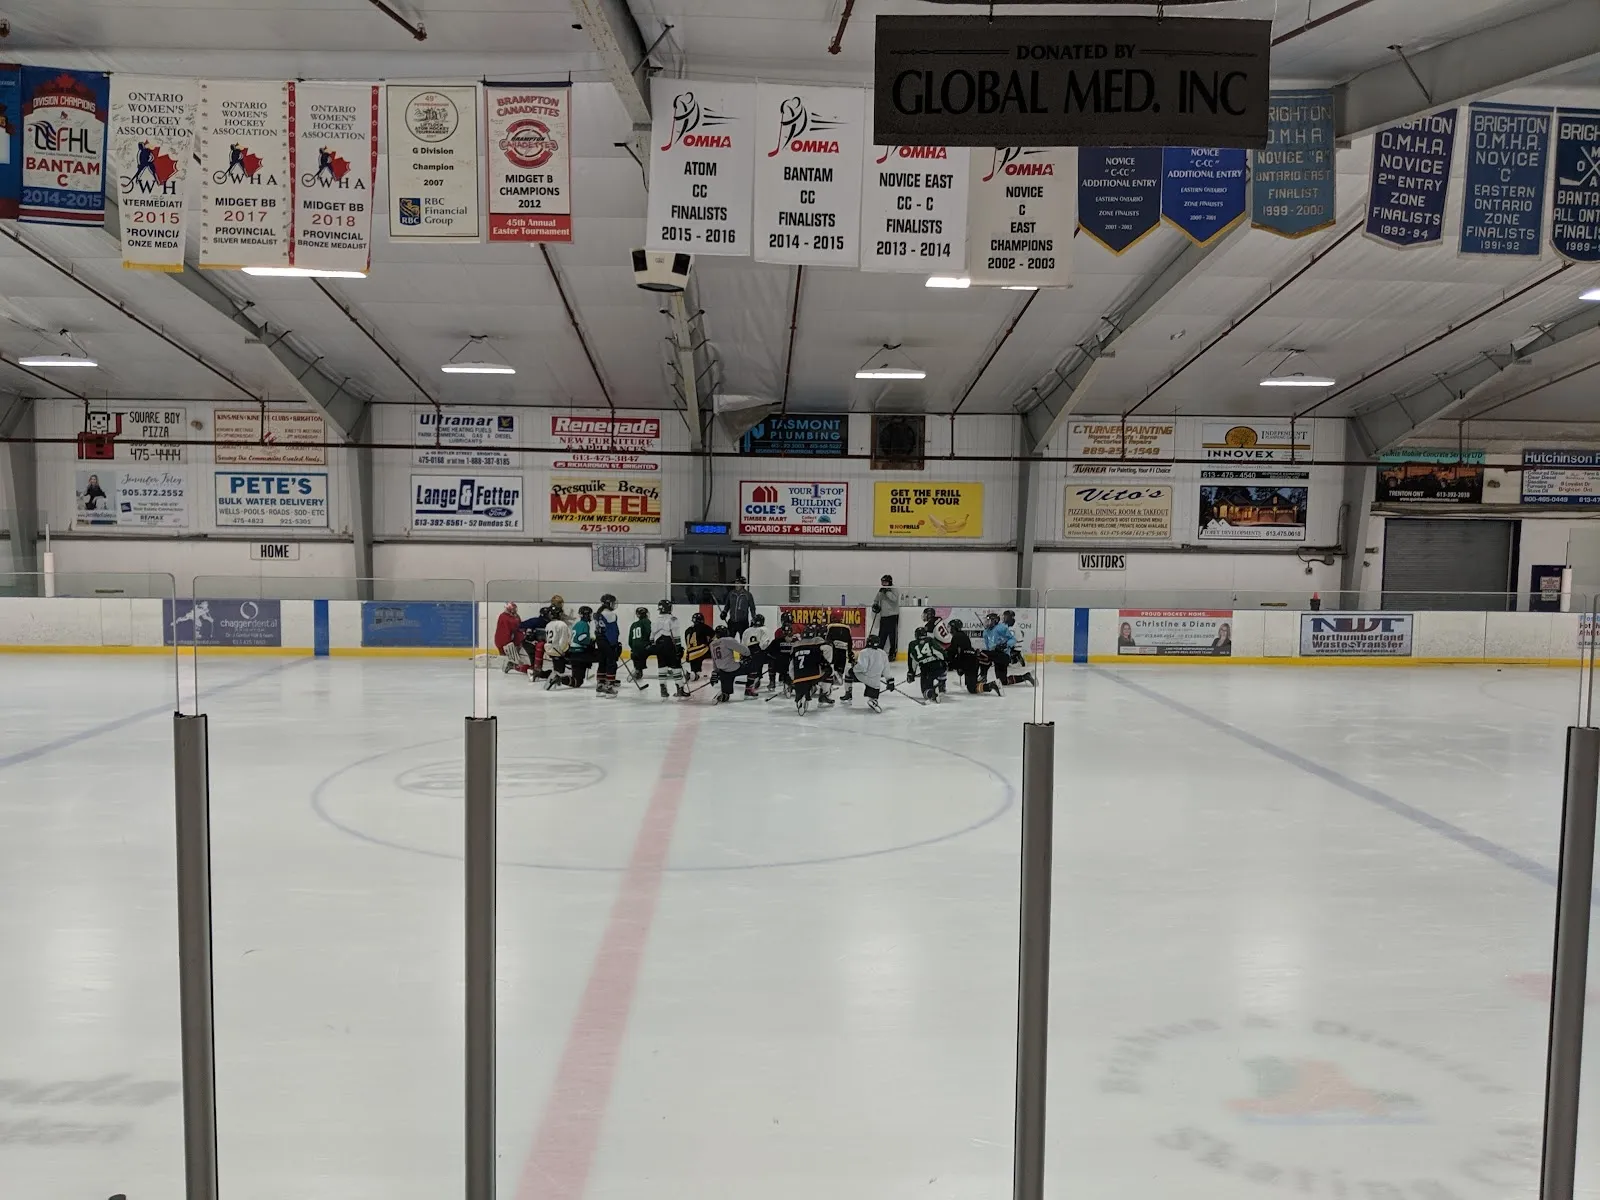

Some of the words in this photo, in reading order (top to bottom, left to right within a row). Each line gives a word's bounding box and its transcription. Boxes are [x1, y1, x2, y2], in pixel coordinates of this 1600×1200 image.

[1016, 45, 1108, 61] DONATED
[1115, 45, 1136, 59] BY
[129, 92, 183, 103] ONTARIO
[892, 69, 1048, 115] GLOBAL
[1063, 68, 1160, 114] MED.
[1178, 70, 1247, 116] INC
[33, 96, 58, 107] DIVISION
[60, 96, 96, 112] CHAMPIONS
[222, 101, 267, 109] ONTARIO
[496, 95, 559, 107] BRAMPTON
[128, 103, 184, 114] WOMEN'S
[222, 110, 268, 118] WOMEN'S
[311, 105, 356, 113] ONTARIO
[496, 105, 560, 118] CANADETTES
[131, 115, 181, 126] HOCKEY
[225, 118, 265, 127] HOCKEY
[310, 113, 356, 122] WOMEN'S
[313, 122, 354, 131] HOCKEY
[1475, 116, 1547, 133] BRIGHTON
[213, 127, 278, 136] ASSOCIATION
[301, 131, 365, 140] ASSOCIATION
[683, 135, 731, 148] OMHA
[791, 140, 839, 154] OMHA
[1381, 132, 1446, 155] O.M.H.A.
[1476, 132, 1541, 150] O.M.H.A.
[420, 147, 454, 155] Division
[899, 146, 947, 159] OMHA
[1105, 157, 1135, 166] NOVICE
[1380, 154, 1443, 175] NOVICE
[1476, 151, 1538, 166] NOVICE
[26, 157, 100, 175] BANTAM
[413, 163, 454, 171] Champion
[684, 161, 717, 176] ATOM
[1005, 163, 1053, 176] OMHA
[505, 174, 539, 184] MIDGET
[546, 175, 553, 183] B
[784, 167, 833, 182] BANTAM
[1167, 170, 1214, 178] ADDITIONAL
[1216, 170, 1242, 178] ENTRY
[57, 174, 68, 187] C
[879, 173, 921, 189] NOVICE
[925, 174, 953, 189] EAST
[1082, 179, 1130, 188] ADDITIONAL
[1133, 179, 1157, 188] ENTRY
[499, 186, 560, 196] CHAMPIONS
[693, 184, 707, 198] CC
[1006, 186, 1043, 198] NOVICE
[1475, 185, 1535, 197] EASTERN
[23, 188, 102, 208] 2014-2015
[215, 198, 257, 207] MIDGET
[261, 198, 276, 207] BB
[425, 198, 444, 206] RBC
[519, 199, 541, 208] 2012
[800, 191, 815, 204] CC
[1390, 192, 1425, 207] ZONE
[303, 201, 345, 211] MIDGET
[349, 202, 364, 212] BB
[425, 206, 467, 215] Financial
[1019, 205, 1025, 216] C
[1475, 199, 1532, 211] ONTARIO
[134, 211, 179, 224] 2015
[224, 211, 267, 222] 2017
[671, 205, 727, 221] FINALISTS
[1373, 207, 1441, 225] FINALISTS
[1485, 213, 1519, 225] ZONE
[312, 214, 355, 227] 2018
[425, 216, 453, 226] Group
[506, 218, 525, 227] 45th
[527, 219, 556, 227] Annual
[779, 212, 835, 227] FINALISTS
[216, 227, 276, 236] PROVINCIAL
[493, 227, 518, 235] Easter
[521, 227, 569, 236] Tournament
[886, 219, 942, 234] FINALISTS
[1011, 222, 1036, 233] EAST
[1381, 225, 1428, 239] 1993-94
[303, 230, 363, 240] PROVINCIAL
[662, 227, 691, 242] 2015
[706, 229, 735, 243] 2016
[1466, 226, 1535, 240] FINALISTS
[297, 240, 329, 248] BRONZE
[331, 241, 367, 250] MEDALIST
[769, 234, 800, 249] 2014
[814, 236, 844, 250] 2015
[991, 238, 1053, 252] CHAMPIONS
[1481, 241, 1519, 251] 1991-92
[877, 241, 906, 256] 2013
[920, 243, 951, 257] 2014
[988, 258, 1015, 269] 2002
[1028, 258, 1055, 270] 2003
[129, 411, 160, 424] SQUARE
[165, 413, 181, 424] BOY
[771, 419, 840, 430] TASMONT
[1124, 426, 1172, 435] PAINTING
[143, 426, 169, 438] PIZZA
[771, 432, 840, 440] PLUMBING
[130, 449, 180, 461] 475-4444
[1208, 450, 1274, 458] INNOVEX
[1525, 452, 1592, 464] Hutchinson
[231, 477, 312, 495] PETE'S
[618, 481, 659, 500] Beach
[416, 485, 456, 508] Lange
[476, 486, 519, 505] Fetter
[1076, 488, 1165, 502] Vito's
[280, 498, 324, 506] DELIVERY
[552, 494, 660, 515] MOTEL
[791, 497, 842, 507] BUILDING
[745, 505, 785, 514] COLE'S
[261, 544, 289, 558] HOME
[1081, 555, 1124, 569] VISITORS
[632, 626, 641, 640] 10
[914, 642, 932, 658] 14
